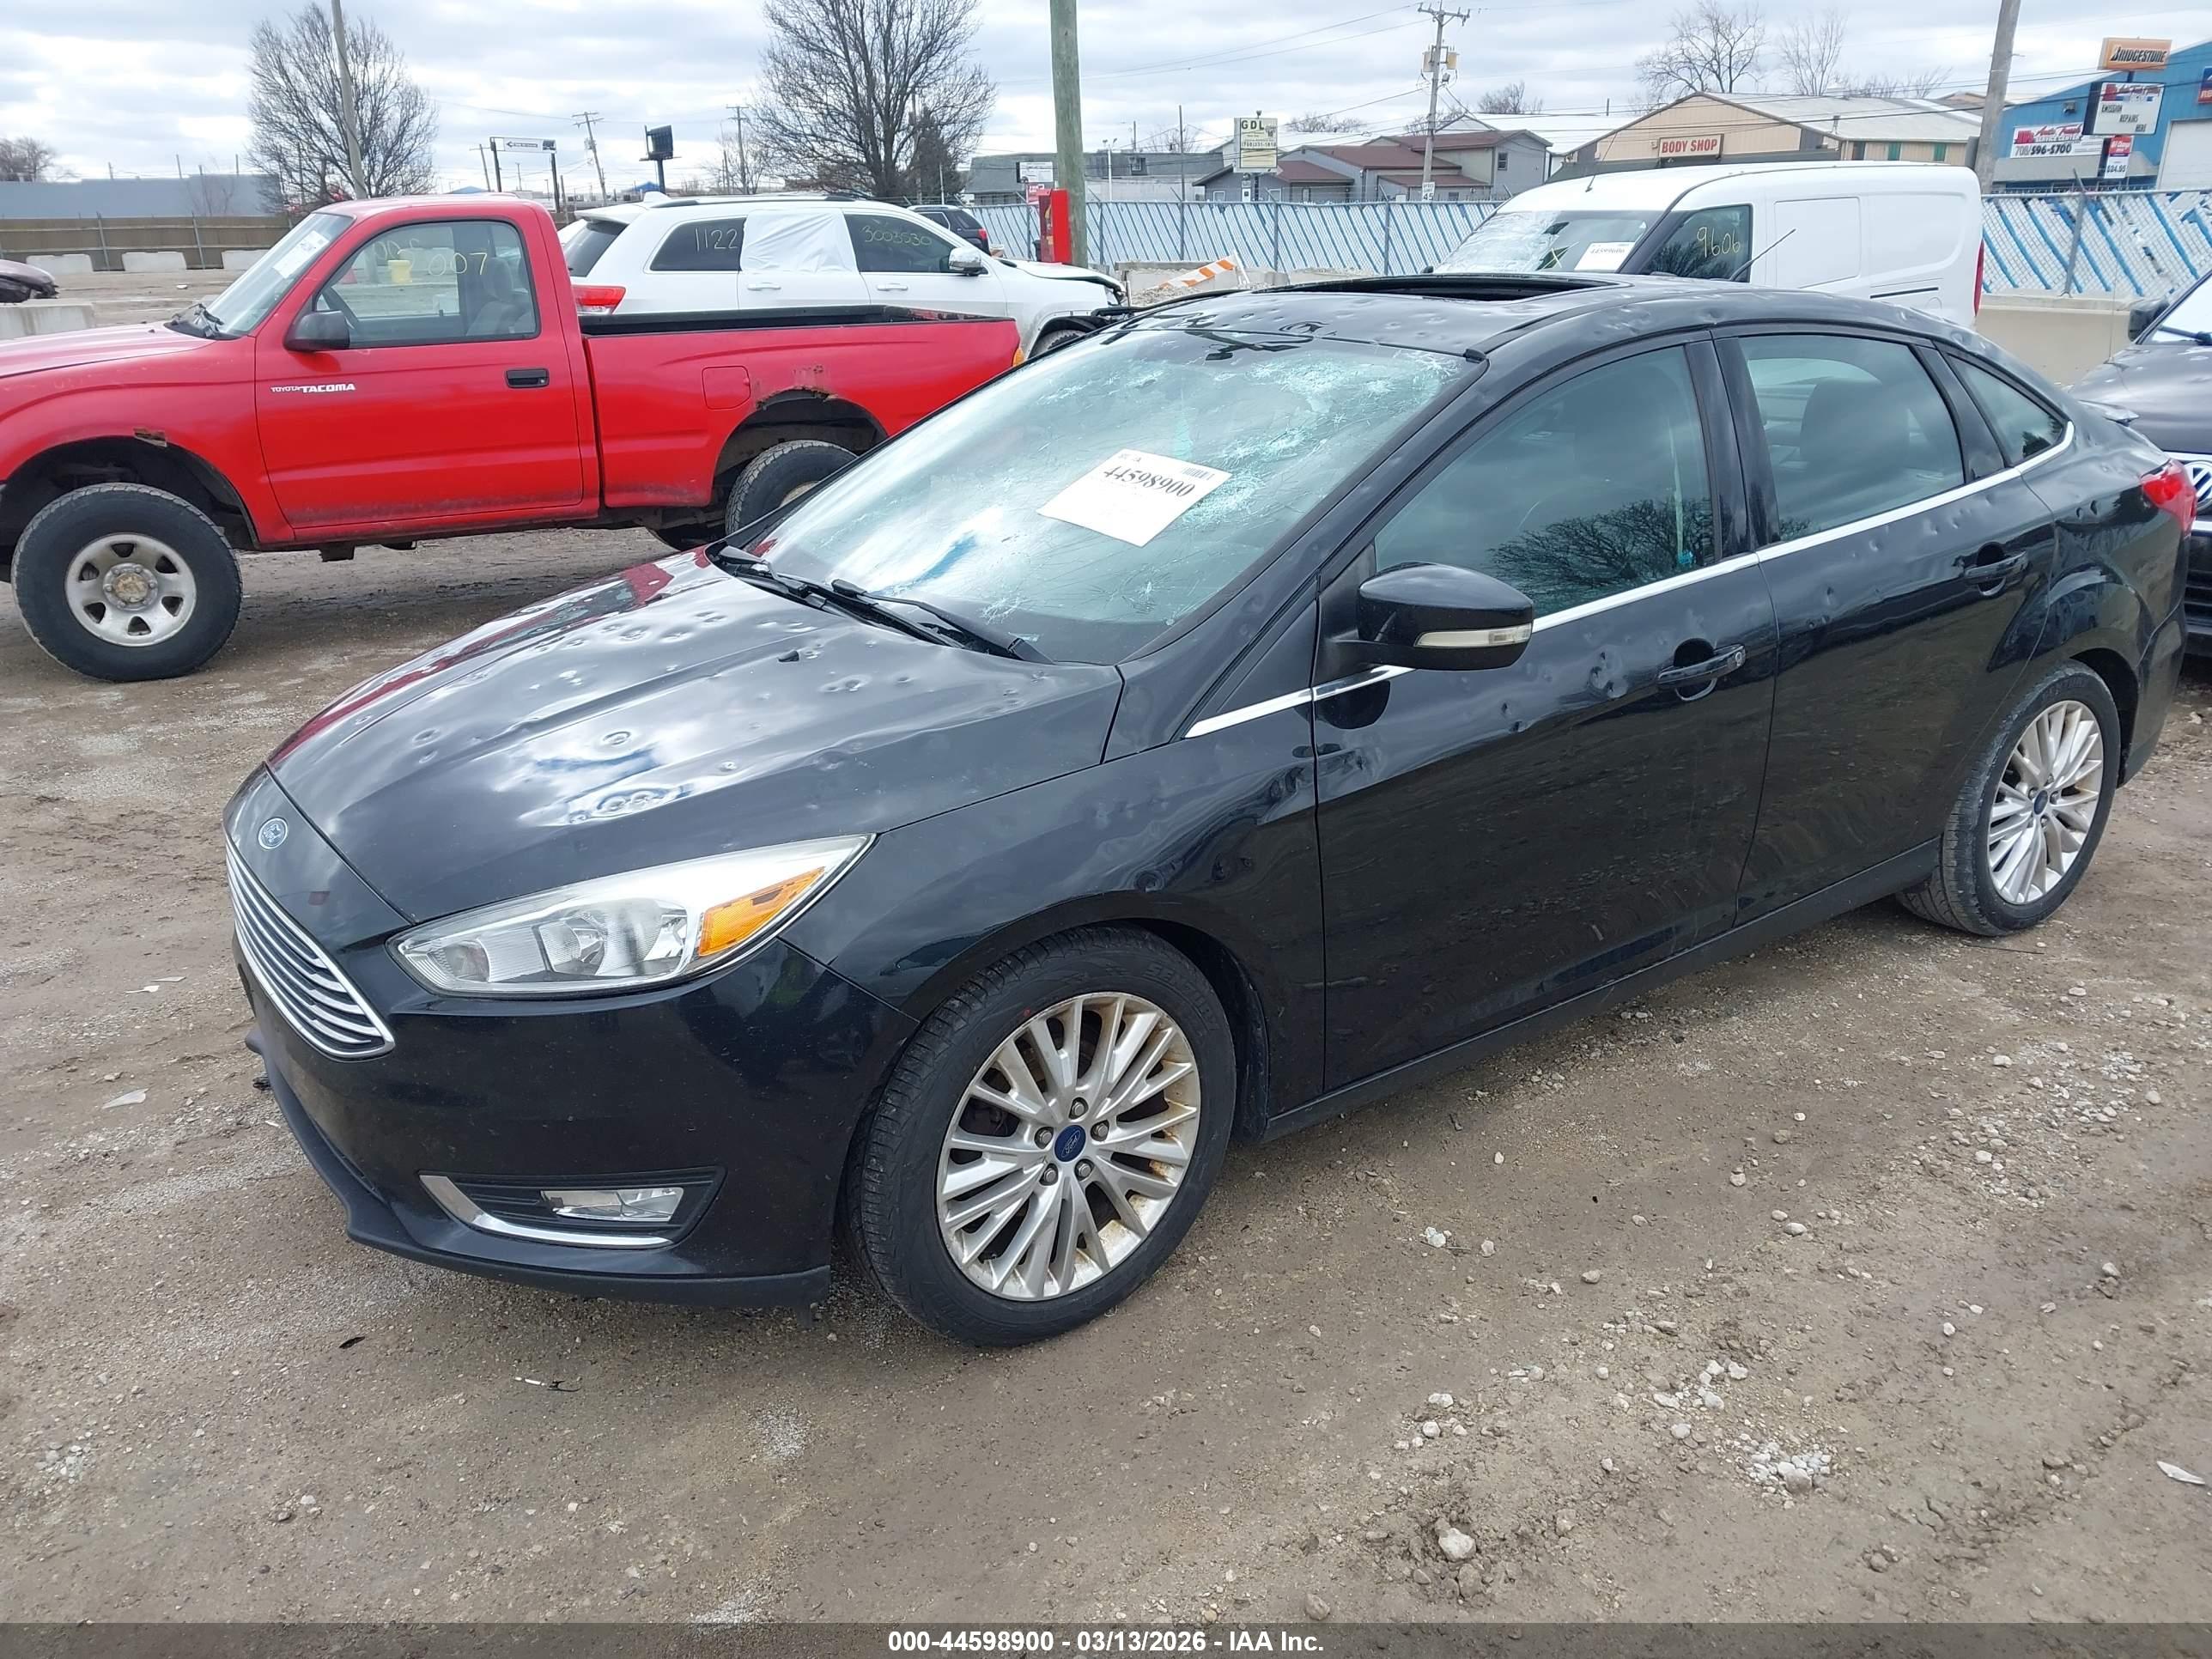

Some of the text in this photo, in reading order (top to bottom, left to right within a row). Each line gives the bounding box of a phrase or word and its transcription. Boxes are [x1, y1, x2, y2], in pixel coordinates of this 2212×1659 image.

[2110, 46, 2167, 63] BRIDGESTONE
[1662, 138, 1718, 154] BODY SHOP
[695, 228, 738, 252] 1122
[1697, 227, 1741, 258] 9606
[301, 383, 356, 392] TACOMA
[1103, 465, 1196, 497] 44598900
